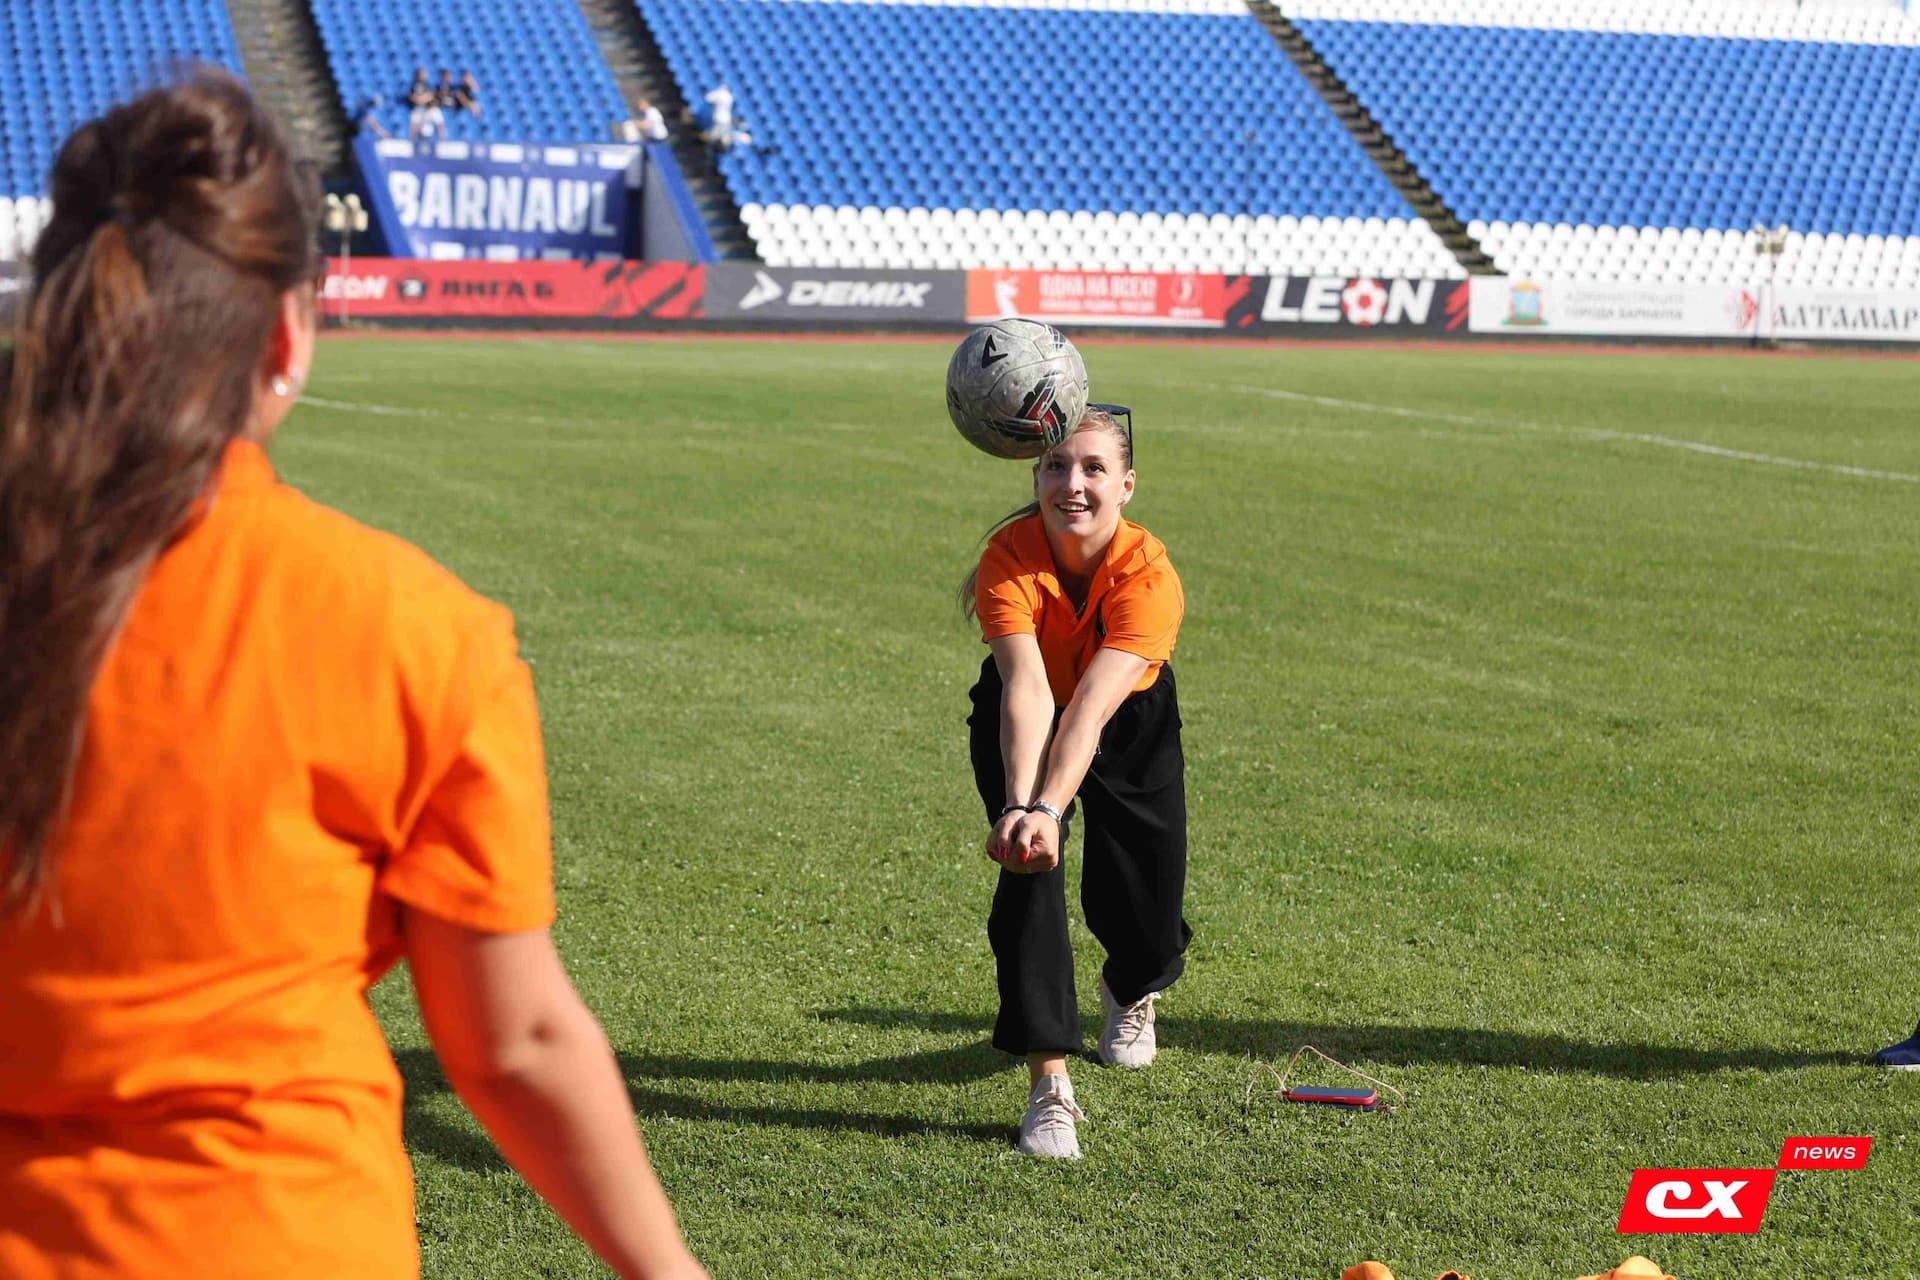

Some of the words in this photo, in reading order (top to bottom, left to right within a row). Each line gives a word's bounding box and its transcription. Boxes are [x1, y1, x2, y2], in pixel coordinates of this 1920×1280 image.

[388, 171, 616, 236] BARNAUL
[319, 275, 388, 299] EON
[787, 280, 932, 308] DEMIX
[1261, 277, 1436, 325] LEON
